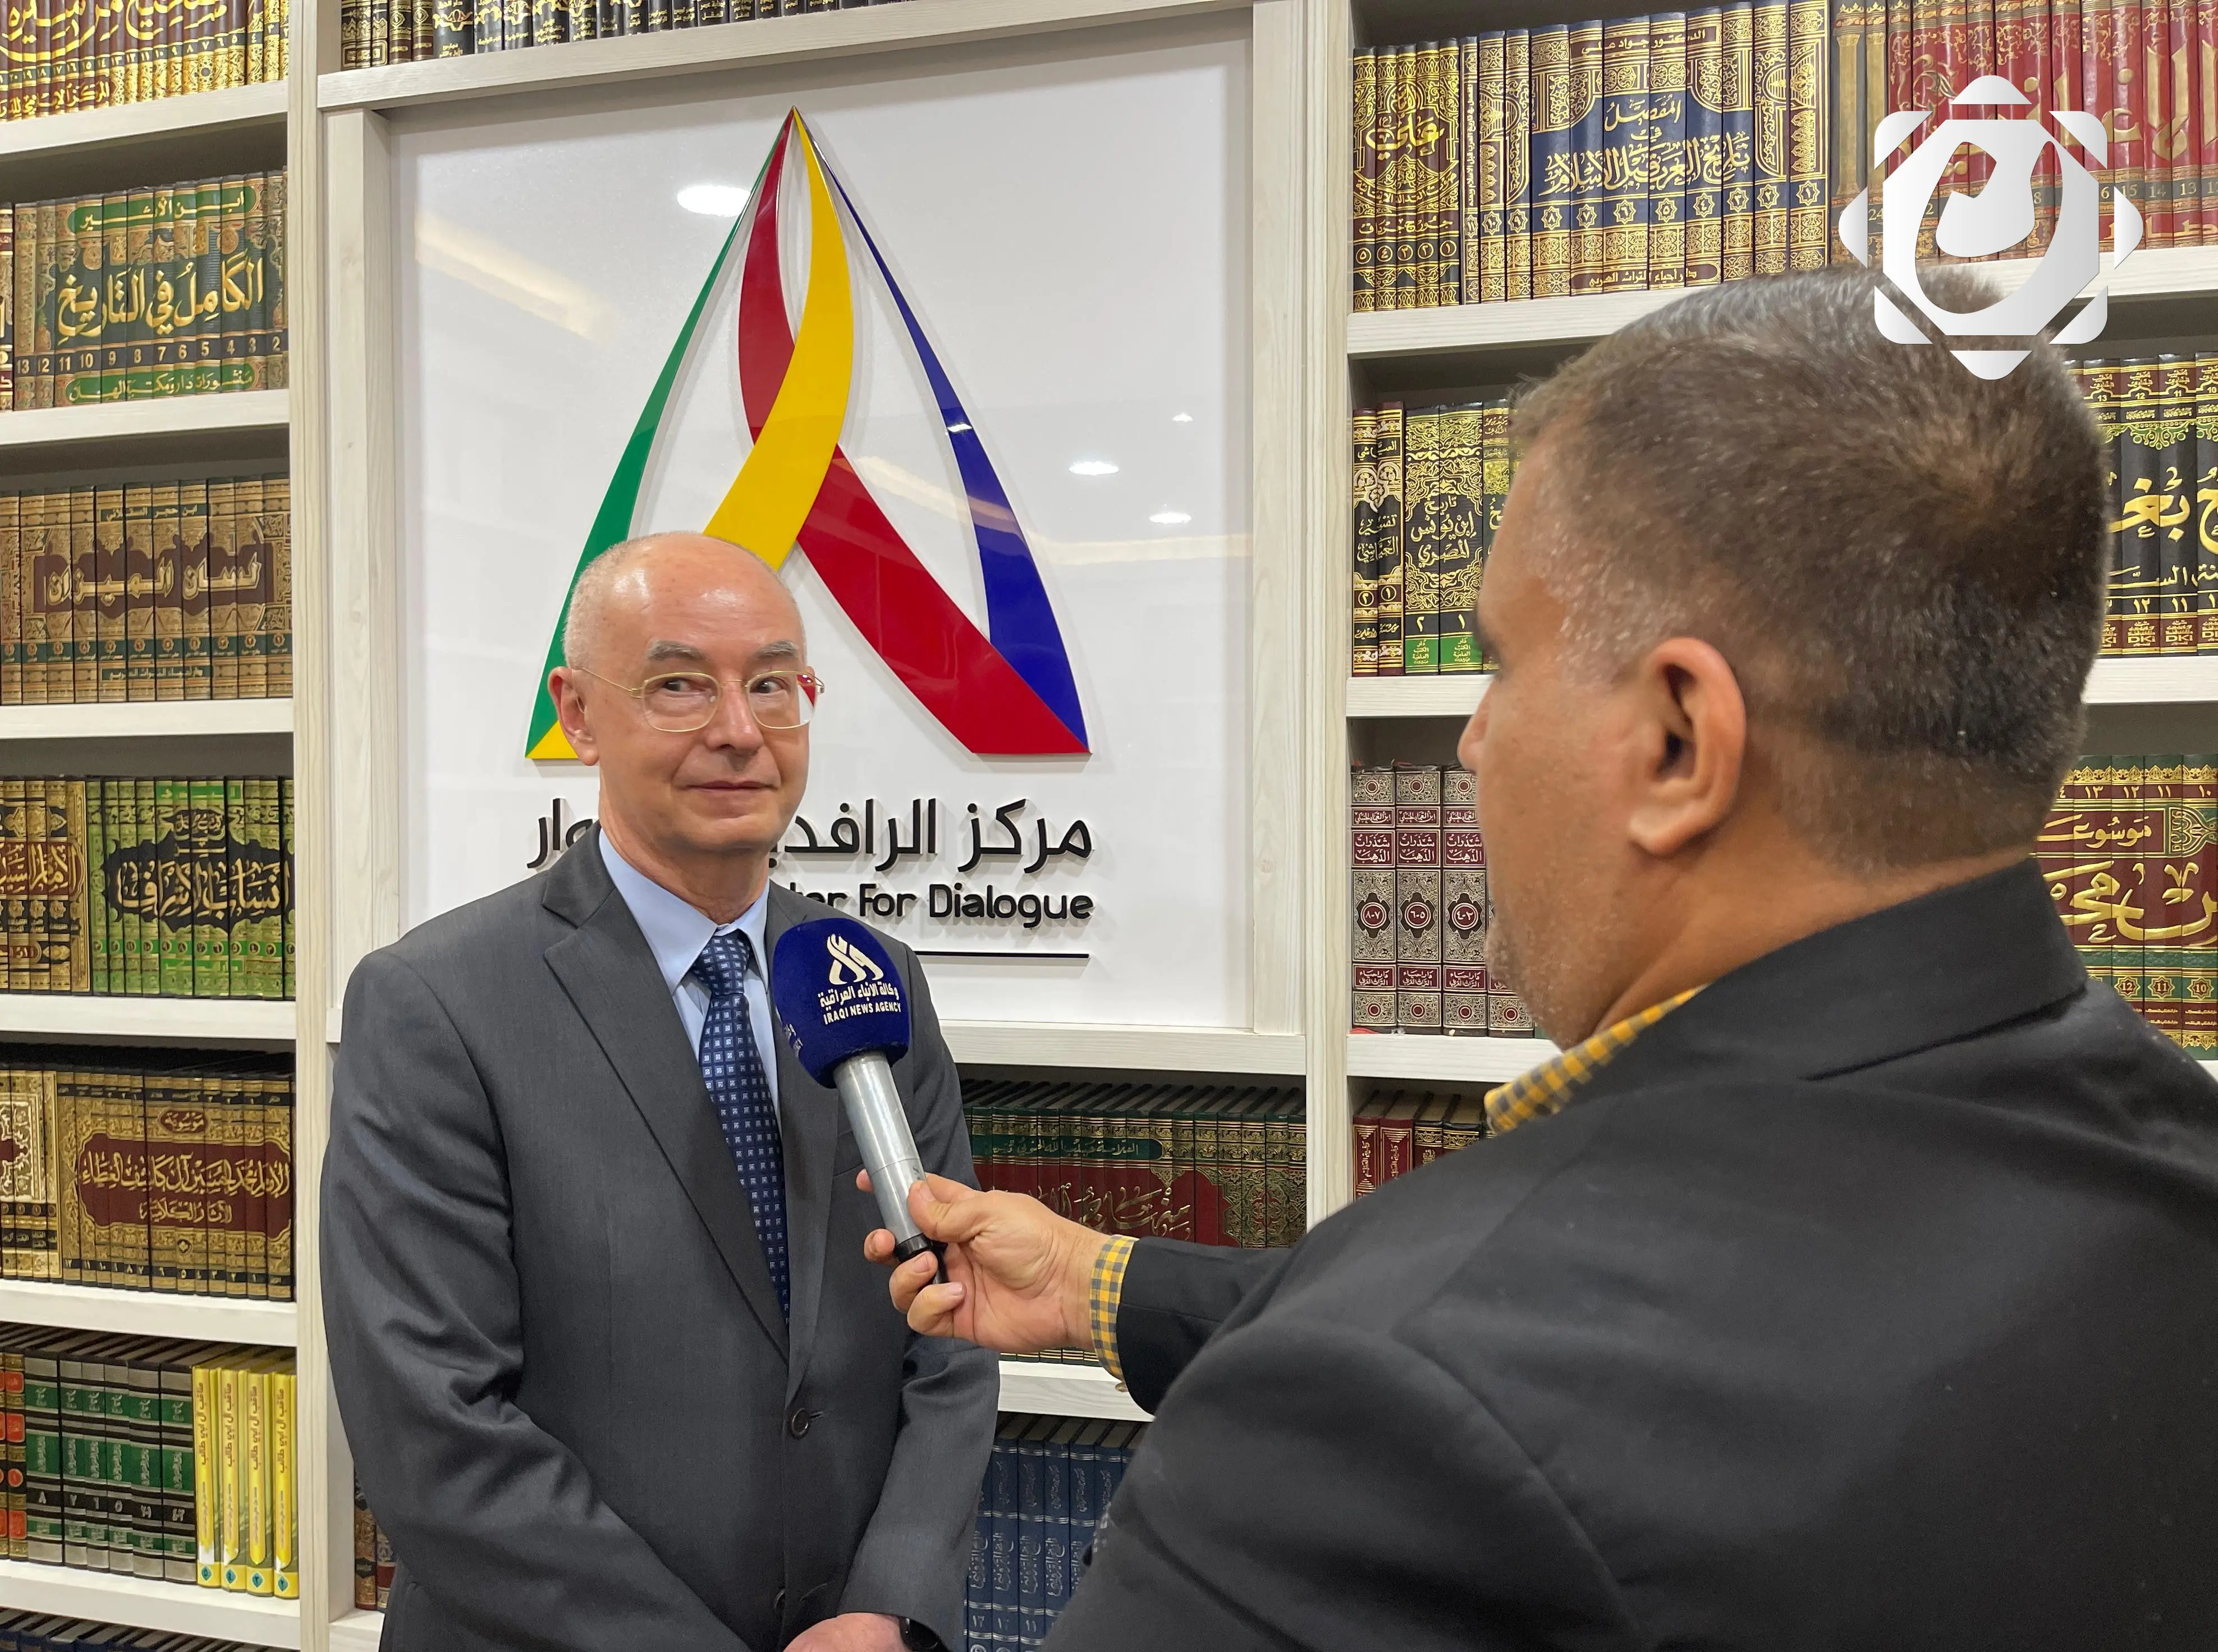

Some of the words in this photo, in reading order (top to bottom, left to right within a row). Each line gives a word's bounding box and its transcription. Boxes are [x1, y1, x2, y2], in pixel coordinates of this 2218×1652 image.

[1582, 42, 1615, 57] علي
[1619, 38, 1649, 48] جواد
[1805, 187, 1812, 198] ١
[2148, 186, 2166, 199] 14
[2180, 181, 2197, 196] 13
[1621, 206, 1628, 216] ٦
[1701, 199, 1707, 210] ٤
[1548, 213, 1556, 224] ٨
[1583, 211, 1590, 221] ٧
[1359, 250, 1368, 260] ٥
[1381, 250, 1388, 263] ٤
[1445, 245, 1452, 257] ١
[38, 357, 50, 373] 12
[59, 356, 71, 371] 11
[80, 353, 94, 369] 10
[108, 350, 117, 365] 9
[134, 348, 141, 364] 8
[157, 346, 167, 361] 7
[178, 344, 187, 360] 6
[201, 341, 210, 356] 5
[227, 339, 235, 355] 4
[272, 336, 280, 351] 2
[1362, 593, 1368, 604] ٢
[1385, 588, 1391, 599] ١
[2133, 598, 2151, 613] ١٢
[2171, 597, 2188, 612] ١١
[1416, 616, 1425, 632] ٢
[1458, 614, 1465, 629] ١
[2157, 785, 2171, 798] ١١
[2199, 784, 2212, 797] ١٠
[769, 798, 936, 872] الرافد
[957, 798, 1093, 874] مركز
[2037, 813, 2153, 849] موسوع
[1355, 834, 1391, 847] شذرات
[1399, 833, 1435, 847] شذرات
[1446, 833, 1483, 847] شذرات
[1355, 848, 1390, 864] الذهب
[1399, 848, 1435, 863] الذهب
[1446, 848, 1483, 864] الذهب
[859, 883, 918, 917] For
[929, 882, 1094, 929] Dialogue
[879, 981, 900, 1000] وكالة
[2122, 982, 2133, 991] 12
[2157, 983, 2167, 992] 11
[2196, 984, 2207, 993] 10
[818, 985, 856, 1011] العراقية
[823, 1007, 849, 1025] IRAQI
[850, 1003, 874, 1016] NEWS
[875, 1001, 901, 1012] AGENCY
